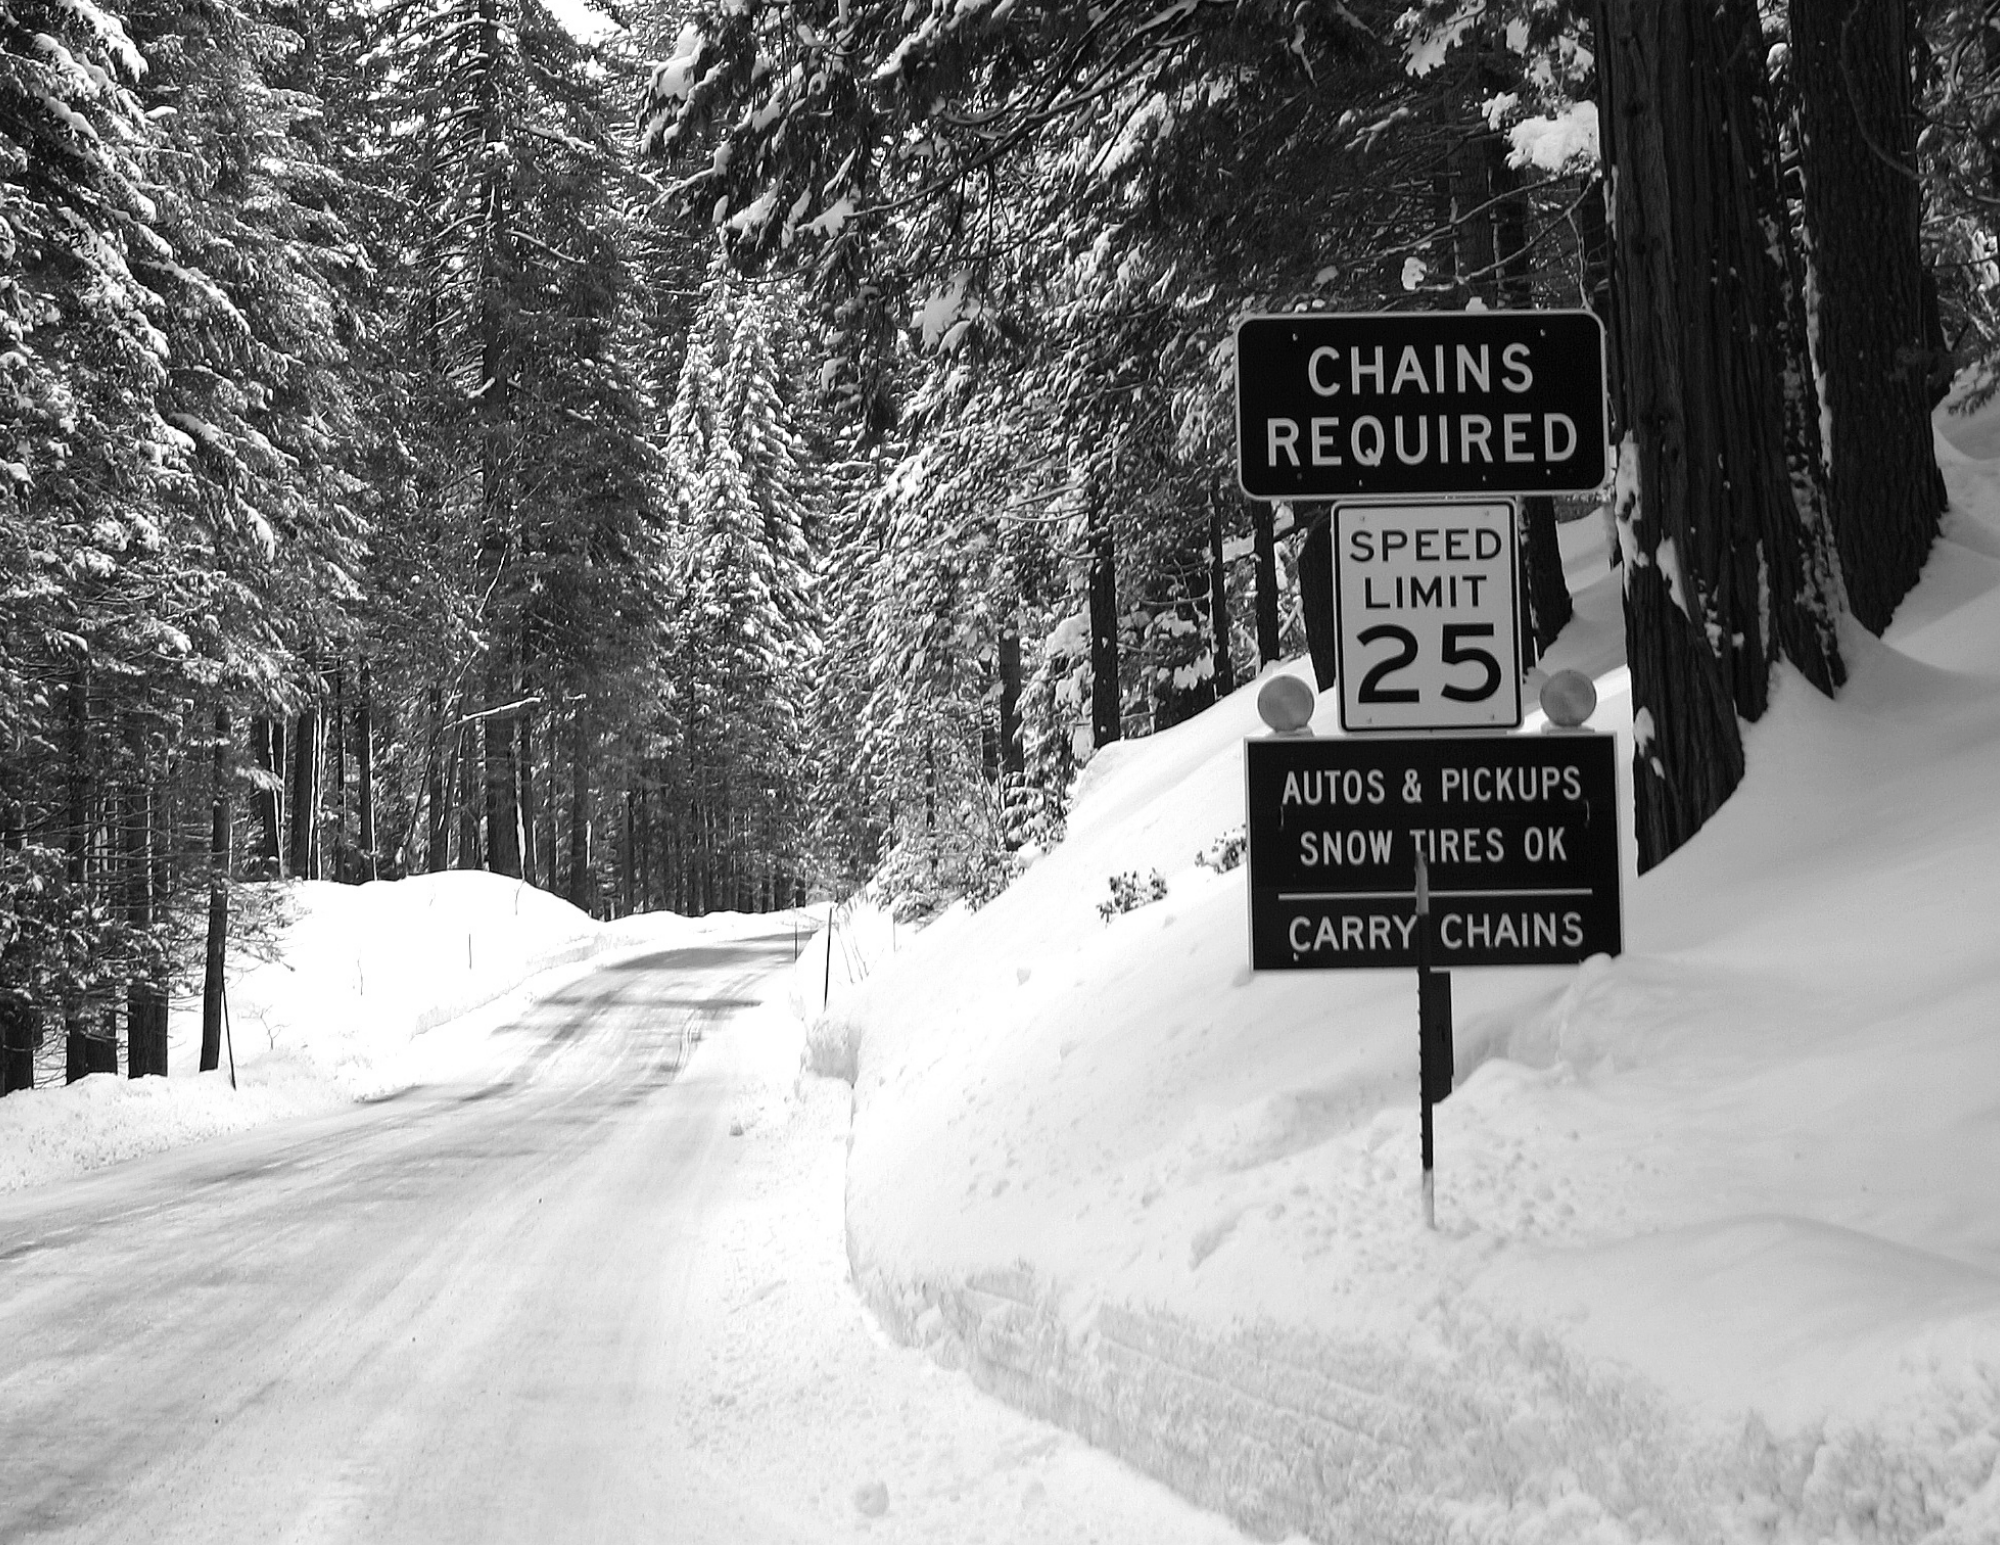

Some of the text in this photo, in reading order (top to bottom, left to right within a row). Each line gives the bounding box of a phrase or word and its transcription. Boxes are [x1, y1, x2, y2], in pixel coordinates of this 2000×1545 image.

[1307, 343, 1534, 397] CHAINS
[1266, 413, 1578, 468] REQUIRED
[1349, 527, 1503, 564] SPEED
[1364, 574, 1489, 610] LIMIT
[1356, 622, 1503, 705] 25
[1281, 766, 1582, 805] AUTOS & PICKUPS
[1299, 827, 1568, 866] SNOW TIRES OK
[1288, 912, 1584, 952] CARRY CHAINS
